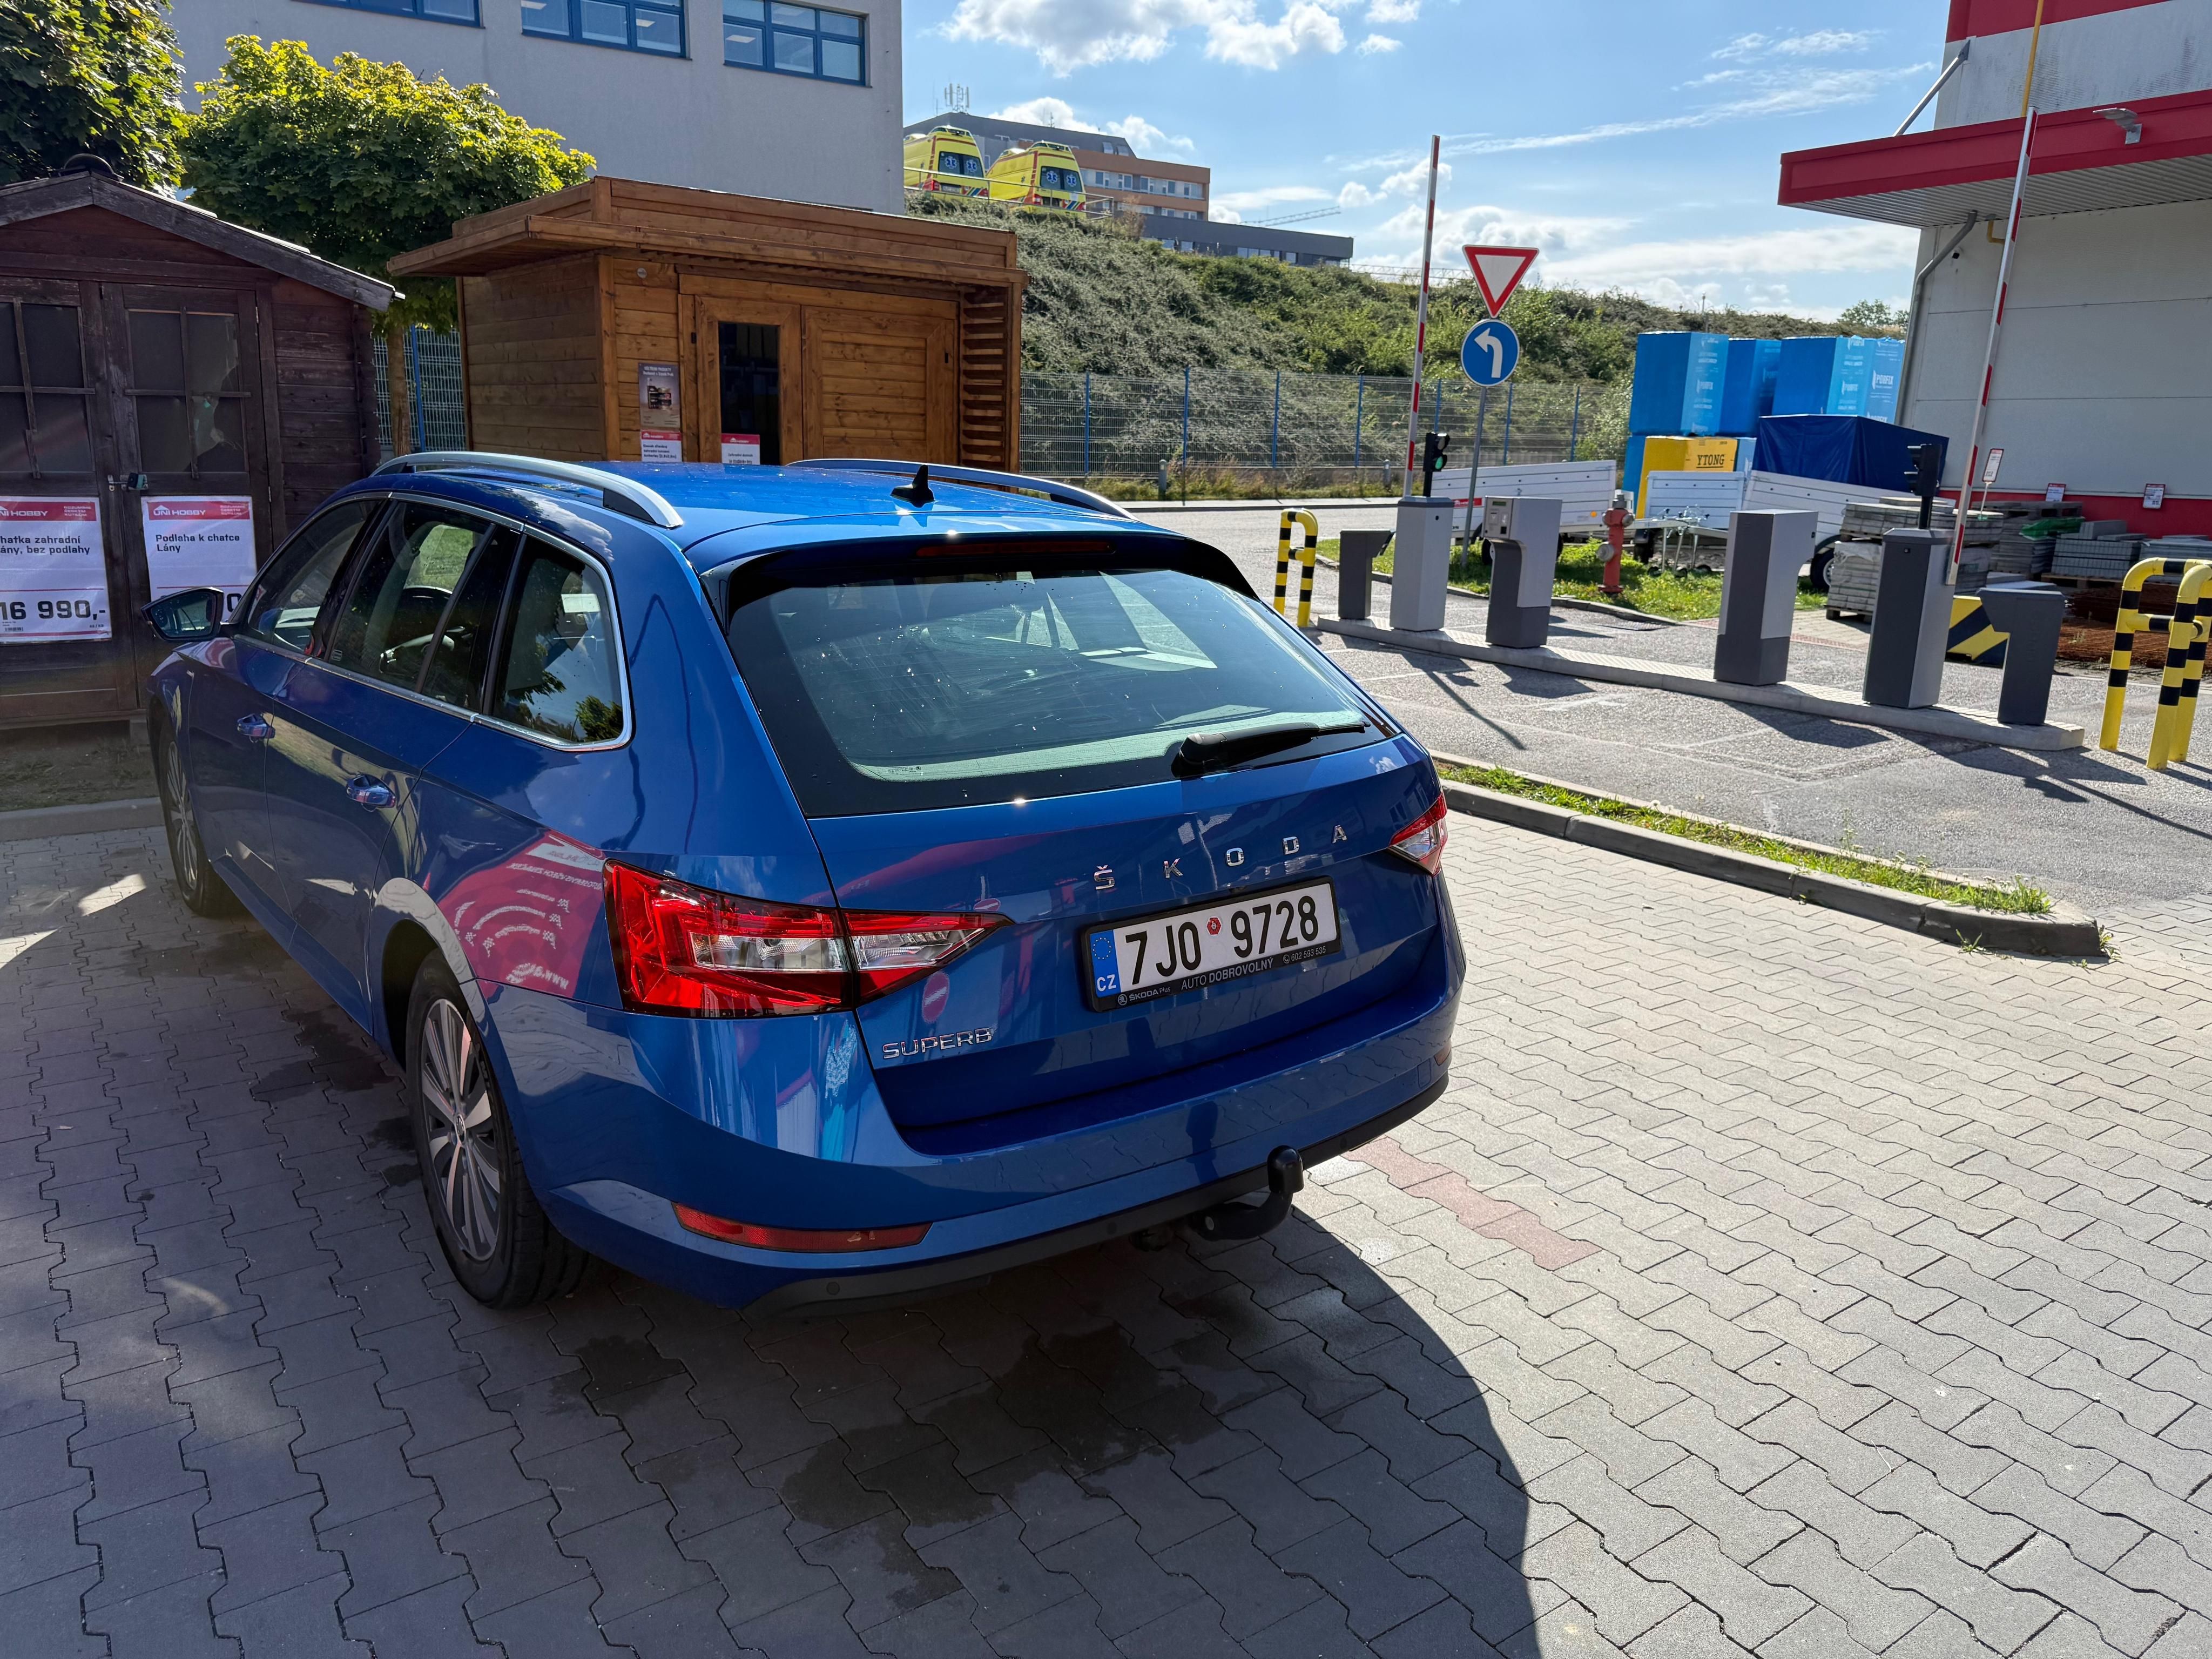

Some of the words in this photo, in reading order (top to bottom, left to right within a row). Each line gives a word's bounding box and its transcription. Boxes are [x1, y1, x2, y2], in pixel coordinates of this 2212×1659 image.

[1697, 454, 1725, 466] YTONG
[0, 536, 31, 544] hatka
[35, 535, 80, 544] zahradní
[157, 543, 181, 553] Lány
[0, 545, 23, 555] ány,
[27, 545, 46, 554] bez
[49, 545, 90, 555] podlahy
[37, 600, 106, 621] 990,-
[1094, 824, 1347, 890] ŠKODA
[1125, 921, 1202, 986] 7J0
[1230, 895, 1319, 959] 9728
[1096, 974, 1117, 992] CZ
[1129, 989, 1159, 1001] ŠKODA
[1159, 986, 1171, 994] Plus
[1181, 974, 1207, 990] AUTO
[1209, 956, 1274, 983] DOBROVOLNÝ
[1291, 952, 1302, 962] 602
[1303, 949, 1314, 959] 593
[1316, 946, 1326, 956] 535
[882, 1027, 993, 1060] SUPERB
